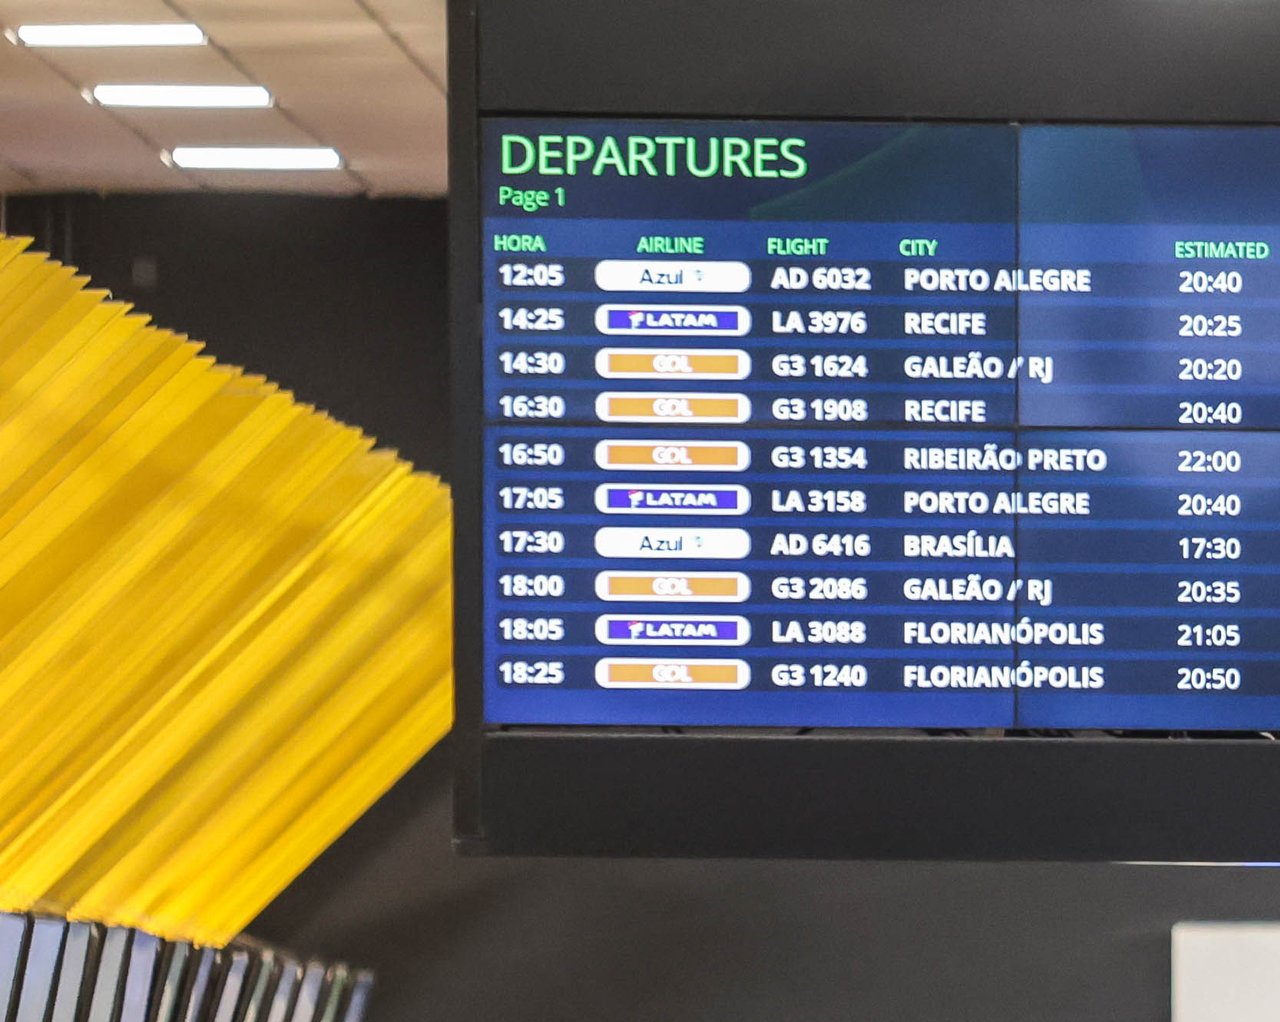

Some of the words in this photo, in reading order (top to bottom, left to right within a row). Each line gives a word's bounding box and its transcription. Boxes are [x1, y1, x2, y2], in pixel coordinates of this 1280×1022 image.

[501, 134, 807, 179] DEPARTURES
[499, 185, 550, 212] Page
[554, 187, 565, 207] 1
[493, 234, 547, 252] HORA
[636, 236, 705, 254] AIRLINE
[767, 237, 830, 256] FLIGHT
[898, 238, 939, 257] CITY
[1174, 240, 1271, 260] ESTIMATED
[498, 263, 565, 287] 12:05
[640, 269, 683, 285] Azul
[770, 266, 809, 290] AD
[811, 266, 872, 291] 6032
[904, 268, 990, 291] PORTO
[993, 268, 1092, 292] ALEGRE
[1178, 270, 1243, 294] 20:40
[498, 307, 565, 331] 14:25
[645, 312, 718, 328] LATAM
[772, 310, 806, 334] LA
[807, 310, 867, 334] 3976
[904, 312, 986, 335] RECIFE
[1178, 314, 1243, 337] 20:25
[498, 351, 566, 374] 14:30
[652, 354, 693, 374] GOL
[771, 354, 807, 377] G3
[810, 354, 869, 378] 1624
[904, 351, 1004, 379] GALEÃO
[1028, 356, 1054, 384] RJ
[1178, 357, 1243, 381] 20:20
[498, 443, 565, 466] 16:50
[652, 445, 693, 465] GOL
[771, 445, 806, 469] G3
[809, 446, 868, 469] 1354
[904, 443, 1023, 471] RIBEIRÃO
[1027, 448, 1108, 471] PRETO
[1177, 449, 1242, 473] 22:00
[499, 530, 565, 554] 17:30
[639, 535, 683, 551] Azul
[770, 533, 809, 556] AD
[811, 533, 871, 557] 6416
[903, 529, 1015, 558] BRASÍLIA
[1178, 537, 1242, 560] 17:30
[499, 617, 565, 641] 18:05
[645, 622, 718, 637] LATAM
[772, 620, 806, 643] LA
[807, 620, 867, 644] 3088
[903, 616, 1105, 645] FLORIANÓPOLIS
[1177, 624, 1241, 647] 21:05
